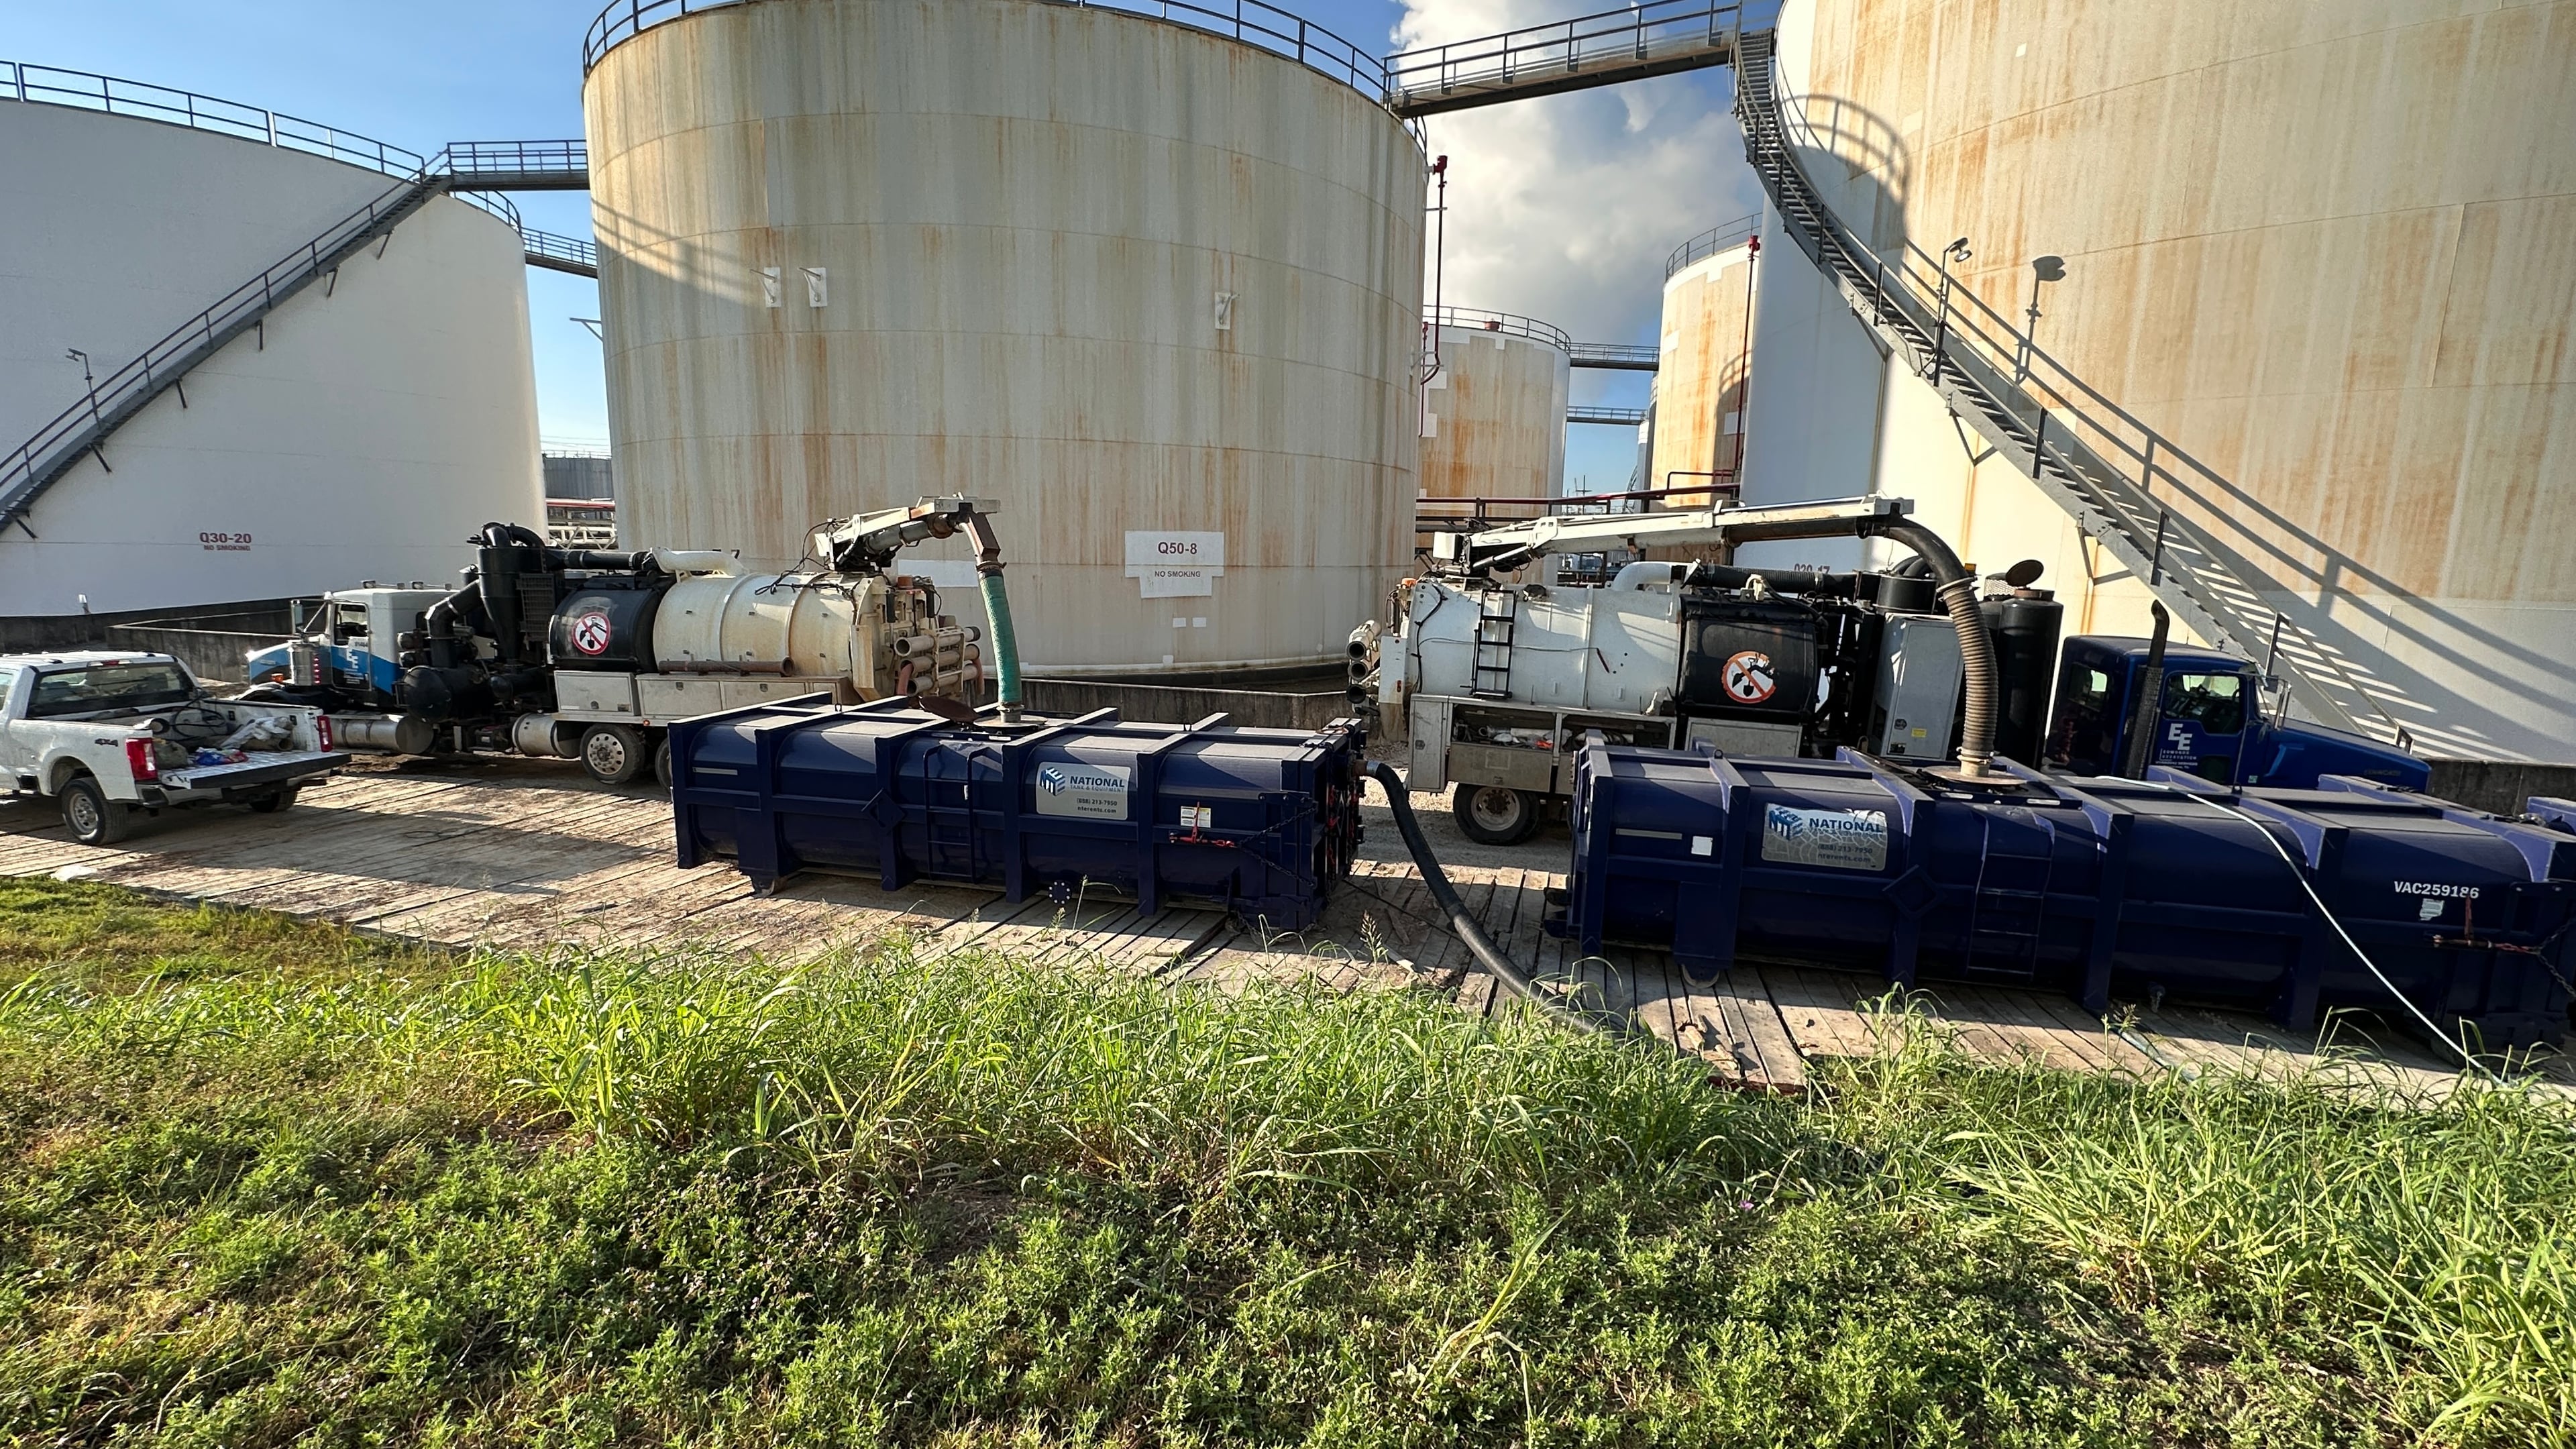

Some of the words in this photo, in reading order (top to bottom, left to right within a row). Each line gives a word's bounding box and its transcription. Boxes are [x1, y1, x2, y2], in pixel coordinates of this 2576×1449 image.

[199, 532, 252, 543] Q30-20
[1158, 541, 1197, 554] Q50-8
[1070, 775, 1125, 788] NATIONAL
[1091, 798, 1118, 806] 213-7950
[1809, 818, 1883, 833] NATIONAL
[1837, 845, 1873, 855] 213-7950
[1818, 853, 1871, 863] nterents.com
[2394, 881, 2479, 899] VAC259186
